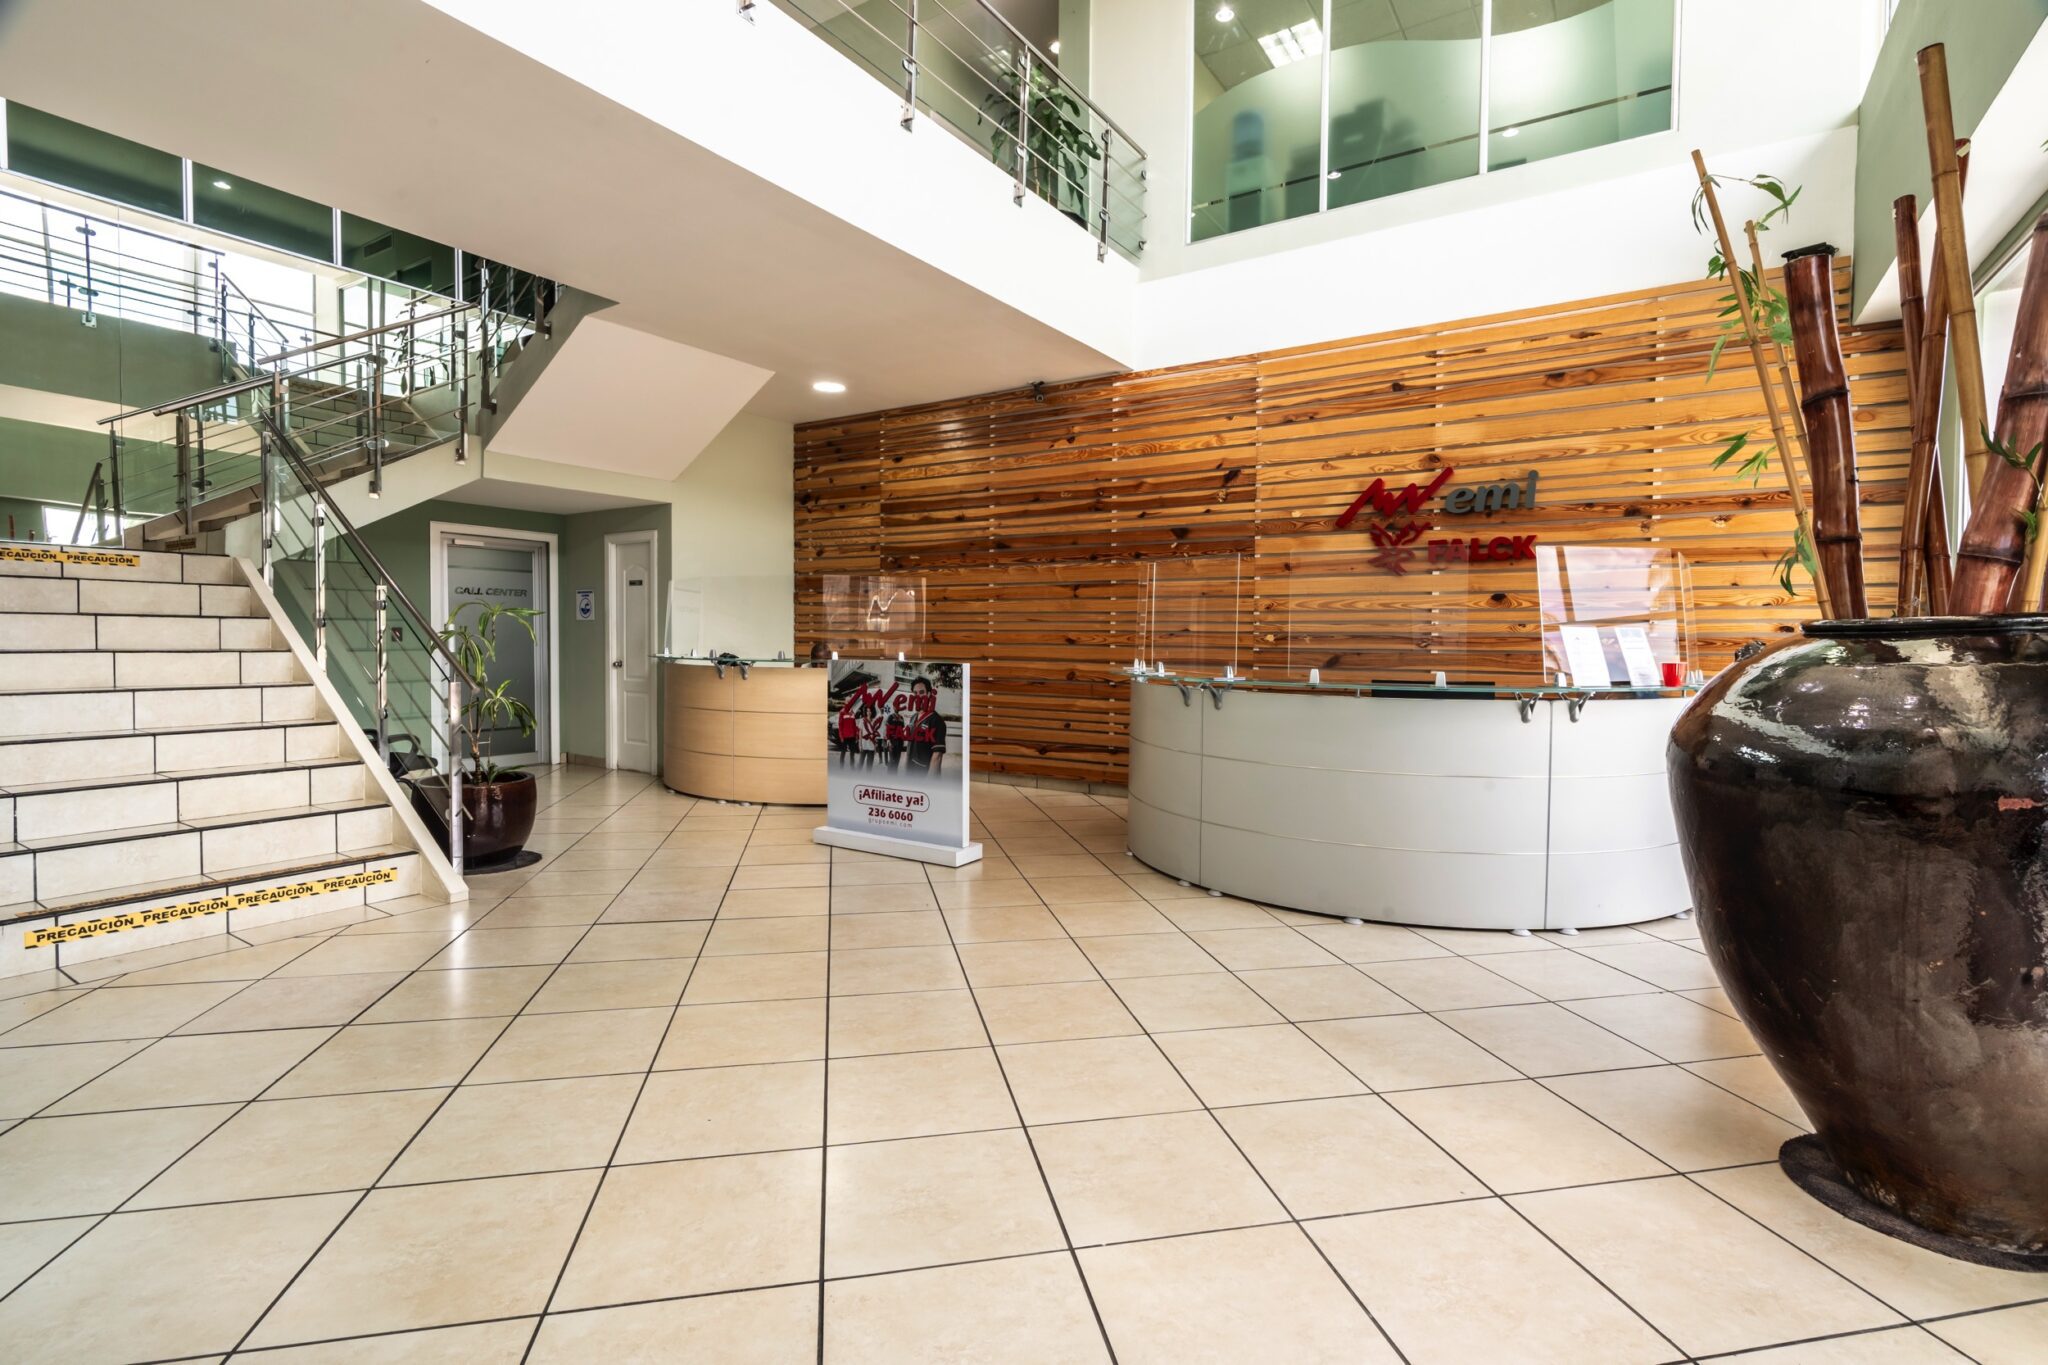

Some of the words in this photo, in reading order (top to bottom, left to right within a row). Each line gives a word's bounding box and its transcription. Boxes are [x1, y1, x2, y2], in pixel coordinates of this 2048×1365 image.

[1445, 469, 1539, 514] emi
[1428, 535, 1537, 562] FALCK
[66, 554, 133, 564] PRECAUCIÓN
[455, 586, 483, 596] CALL
[485, 587, 528, 597] CENTER
[893, 688, 938, 711] emi
[885, 724, 936, 743] FALCK
[905, 795, 924, 807] ya!
[868, 807, 886, 818] 236
[888, 810, 913, 822] 6060
[36, 917, 134, 943] PRECAUCIÓN
[143, 899, 229, 923] PRECAUCIÓN
[237, 885, 314, 906] PRECAUCIÓN
[323, 872, 391, 890] PRECAUCIÓN
